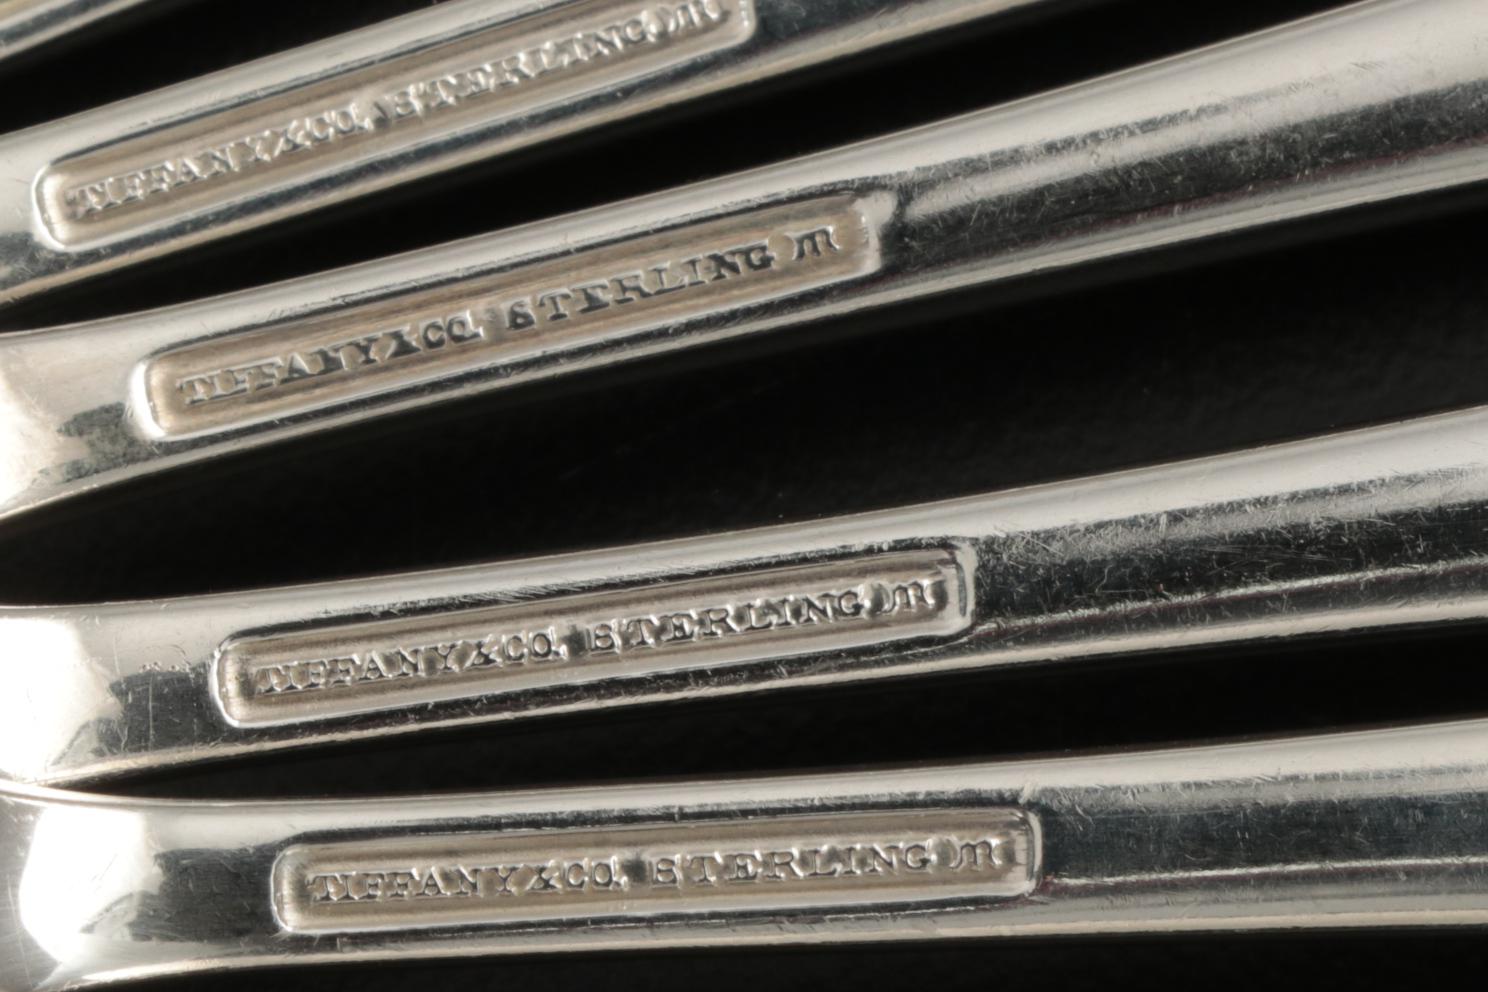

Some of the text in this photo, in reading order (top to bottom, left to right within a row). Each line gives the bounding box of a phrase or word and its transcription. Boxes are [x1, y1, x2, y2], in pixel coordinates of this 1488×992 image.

[385, 7, 660, 120] STERLING
[504, 238, 778, 330] STERLING
[584, 583, 868, 657] STERLING
[650, 837, 932, 889] STERLING
